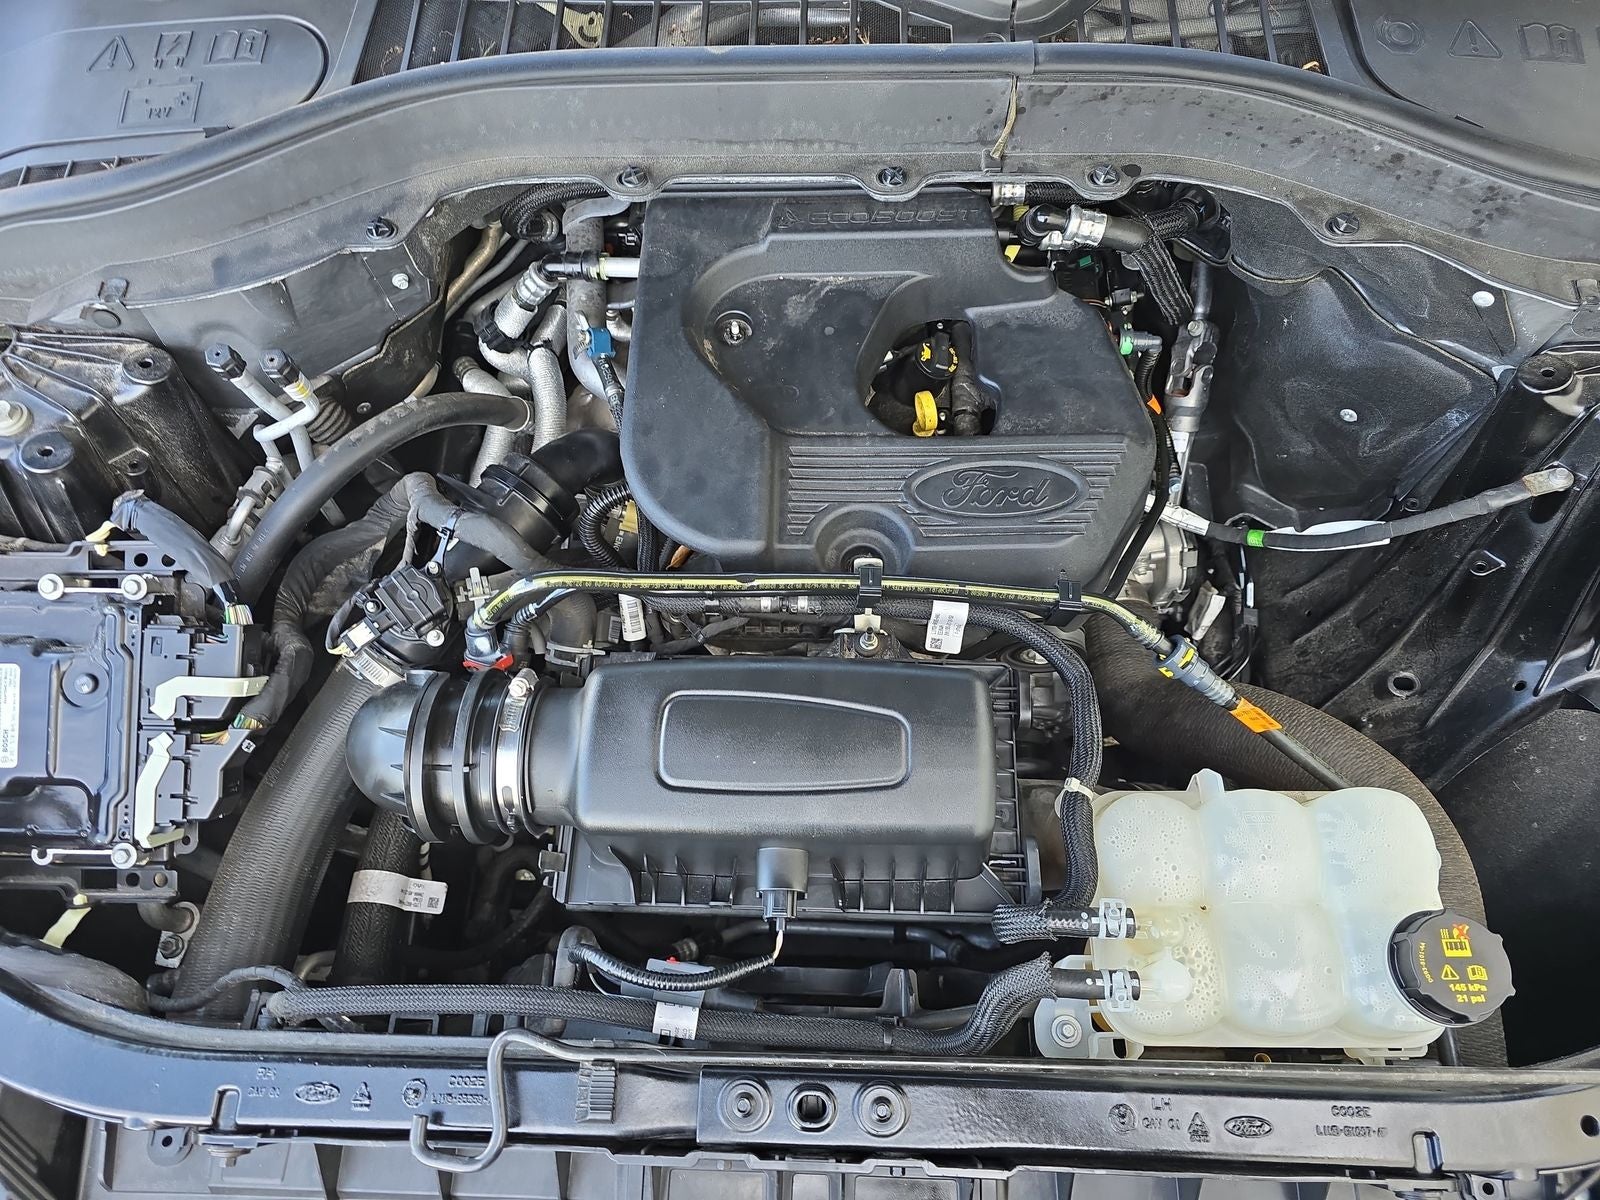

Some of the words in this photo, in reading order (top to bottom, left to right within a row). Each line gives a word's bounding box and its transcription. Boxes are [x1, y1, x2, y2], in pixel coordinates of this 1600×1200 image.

[942, 469, 1052, 508] Ford
[1449, 983, 1467, 992] 145
[1468, 983, 1488, 992] kPa
[1456, 994, 1469, 1003] 21
[1470, 994, 1486, 1004] psi
[1151, 1097, 1173, 1112] LH
